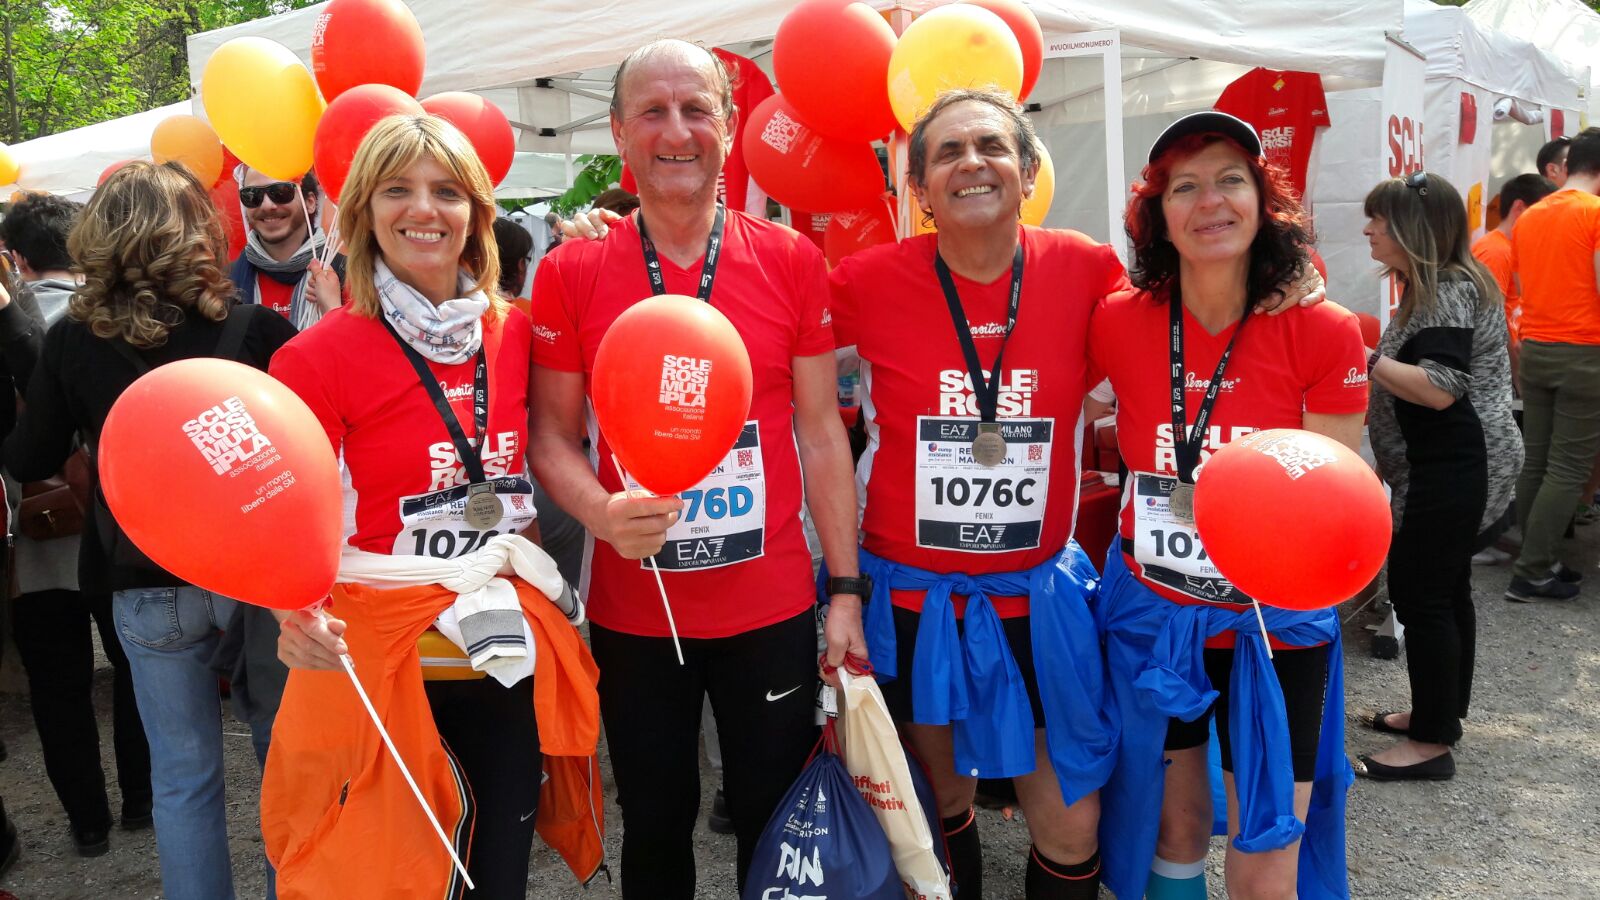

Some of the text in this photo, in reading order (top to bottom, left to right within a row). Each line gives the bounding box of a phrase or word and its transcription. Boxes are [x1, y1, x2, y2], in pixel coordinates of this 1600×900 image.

[663, 354, 709, 372] SCLE
[660, 379, 708, 395] MULT
[1031, 369, 1039, 392] ONLUS
[181, 395, 244, 438] SCLE
[200, 420, 260, 463] MULT
[940, 424, 969, 436] EA7
[229, 446, 277, 478] associazione
[255, 453, 281, 472] italiana
[255, 469, 292, 495] un mondo
[930, 477, 1037, 508] 1076C
[1159, 480, 1178, 491] EA
[241, 475, 296, 513] libero della SM
[672, 485, 754, 522] 76D
[975, 512, 994, 520] FENIX
[690, 526, 710, 534] FENIX
[960, 524, 1007, 543] EA7
[676, 537, 726, 561] EA7
[1185, 574, 1234, 597] EA7
